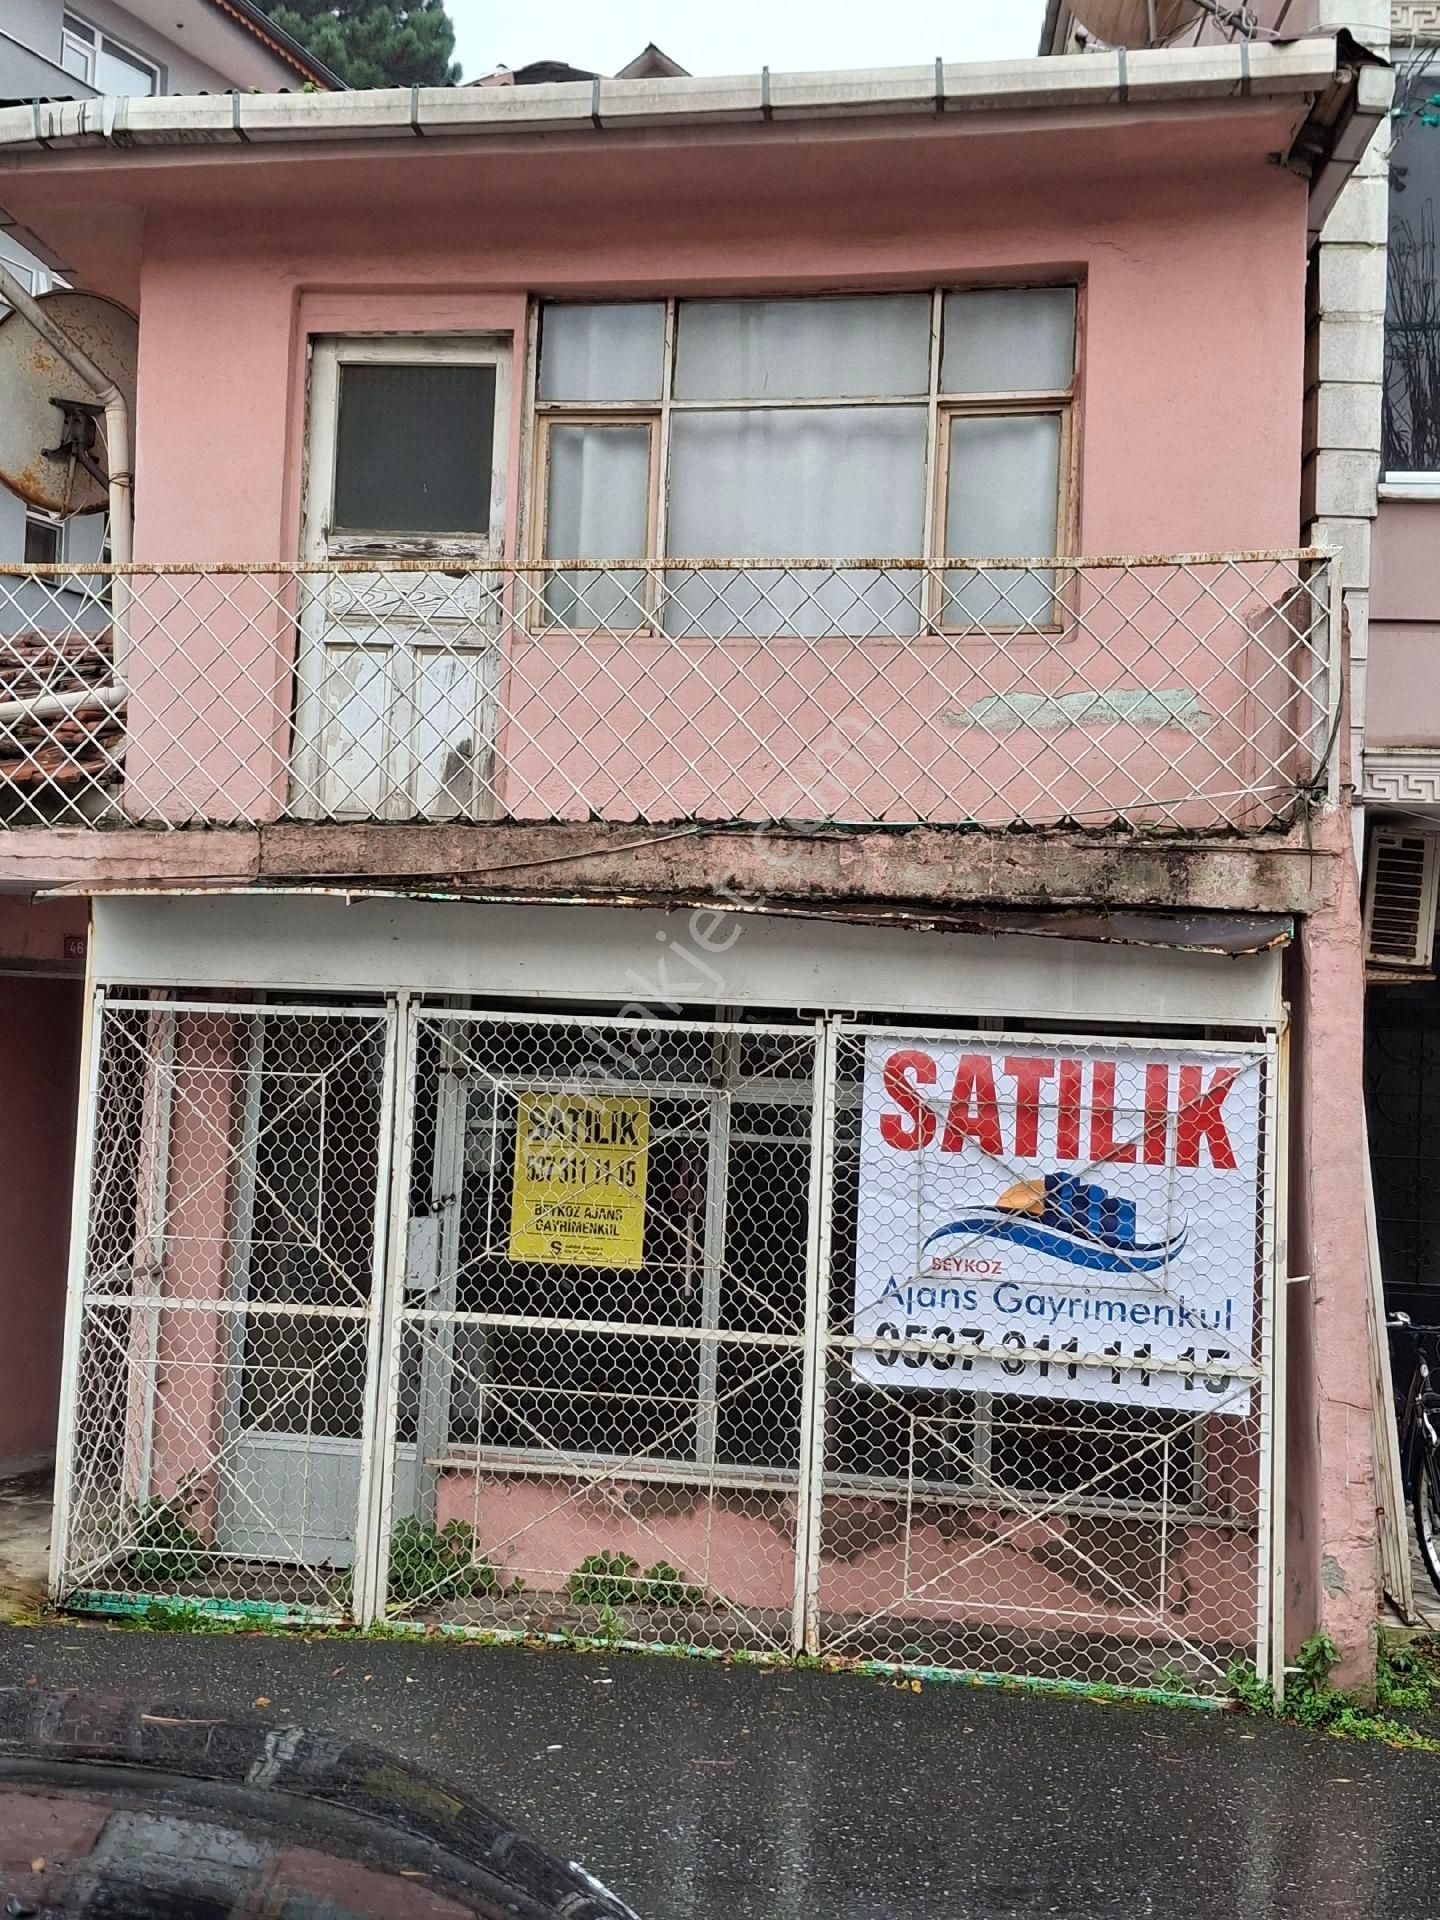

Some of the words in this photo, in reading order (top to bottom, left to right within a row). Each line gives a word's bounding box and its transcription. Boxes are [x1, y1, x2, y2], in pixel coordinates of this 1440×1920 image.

[69, 941, 84, 954] 46
[527, 1107, 639, 1145] SATILIK
[879, 1050, 1241, 1169] SATILIK
[534, 1204, 580, 1218] BEYKOZ
[584, 1207, 623, 1221] AJANS
[931, 1256, 1002, 1276] BEYKOZ
[880, 1276, 977, 1314] Ajans
[993, 1282, 1232, 1331] Gayrimenkul
[1104, 1340, 1152, 1387] 11
[1177, 1347, 1231, 1394] 15
